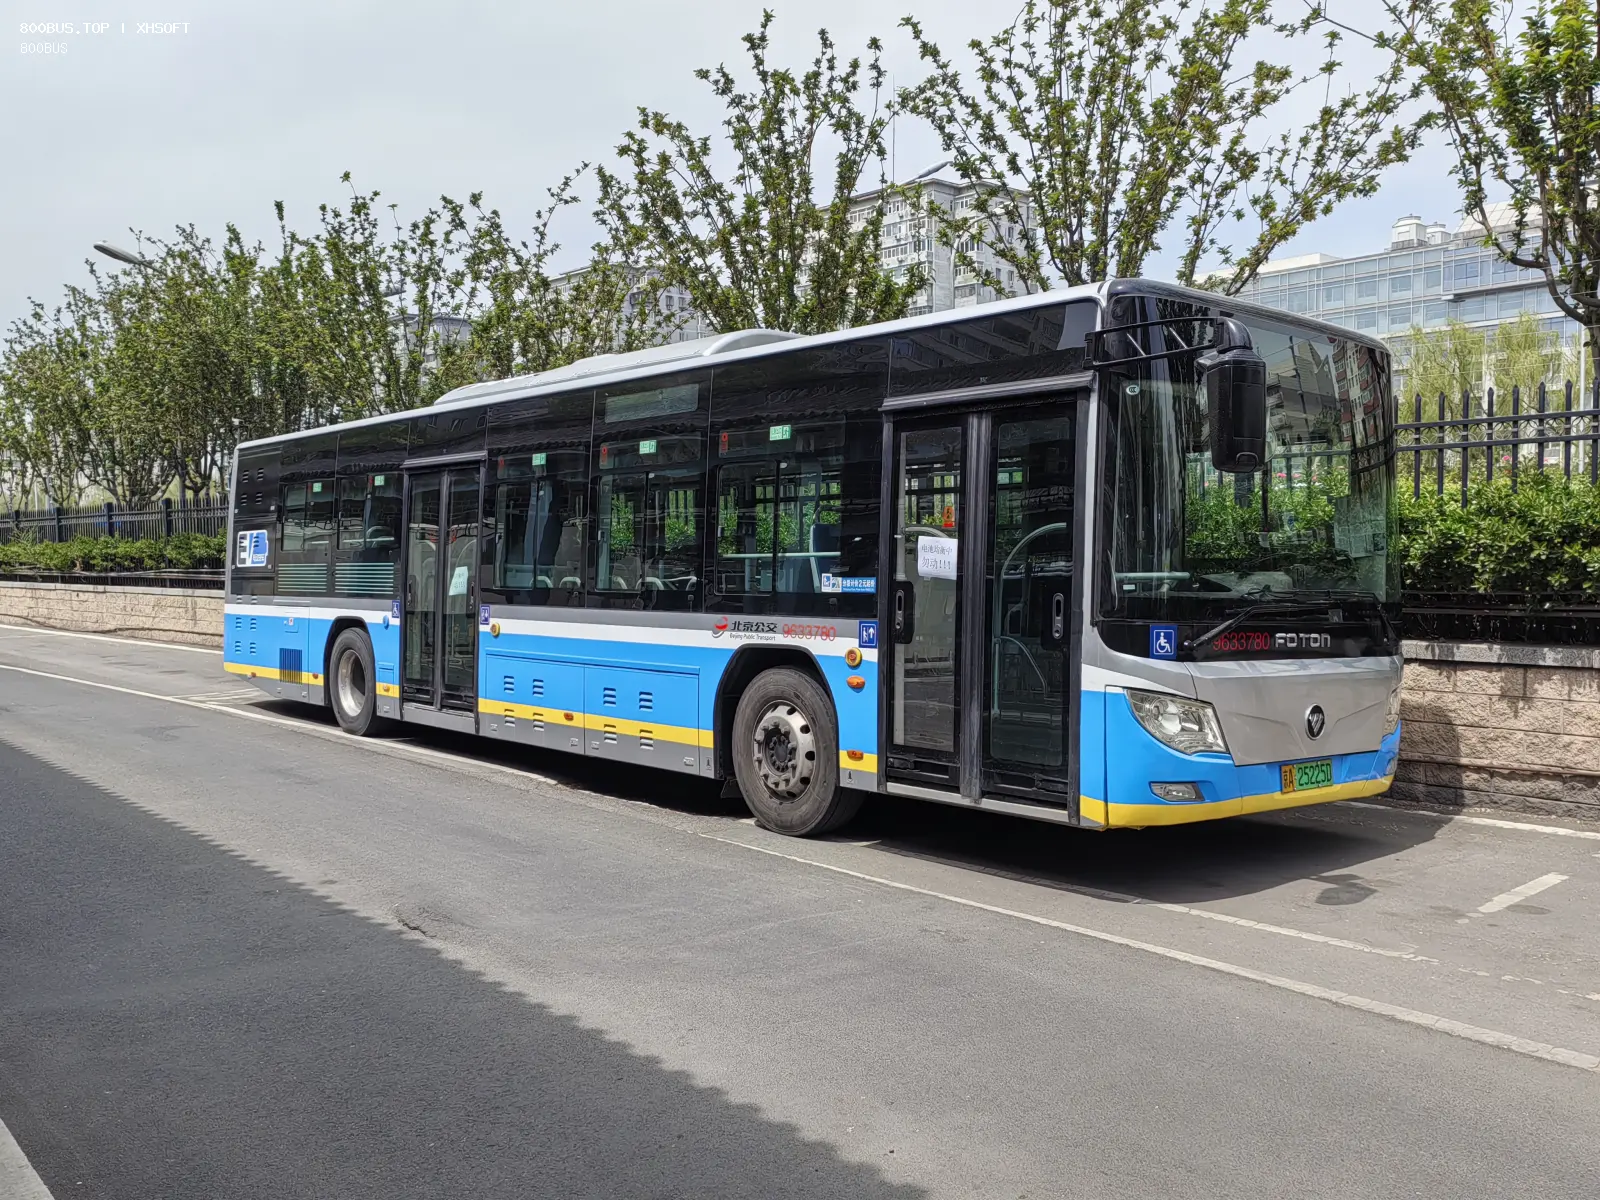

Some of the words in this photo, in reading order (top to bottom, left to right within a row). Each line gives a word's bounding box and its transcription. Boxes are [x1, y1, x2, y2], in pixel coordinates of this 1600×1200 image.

[731, 620, 778, 633] 北京公交
[782, 623, 837, 642] 9633780
[1212, 632, 1271, 651] 9633780
[1275, 633, 1331, 648] FOTON
